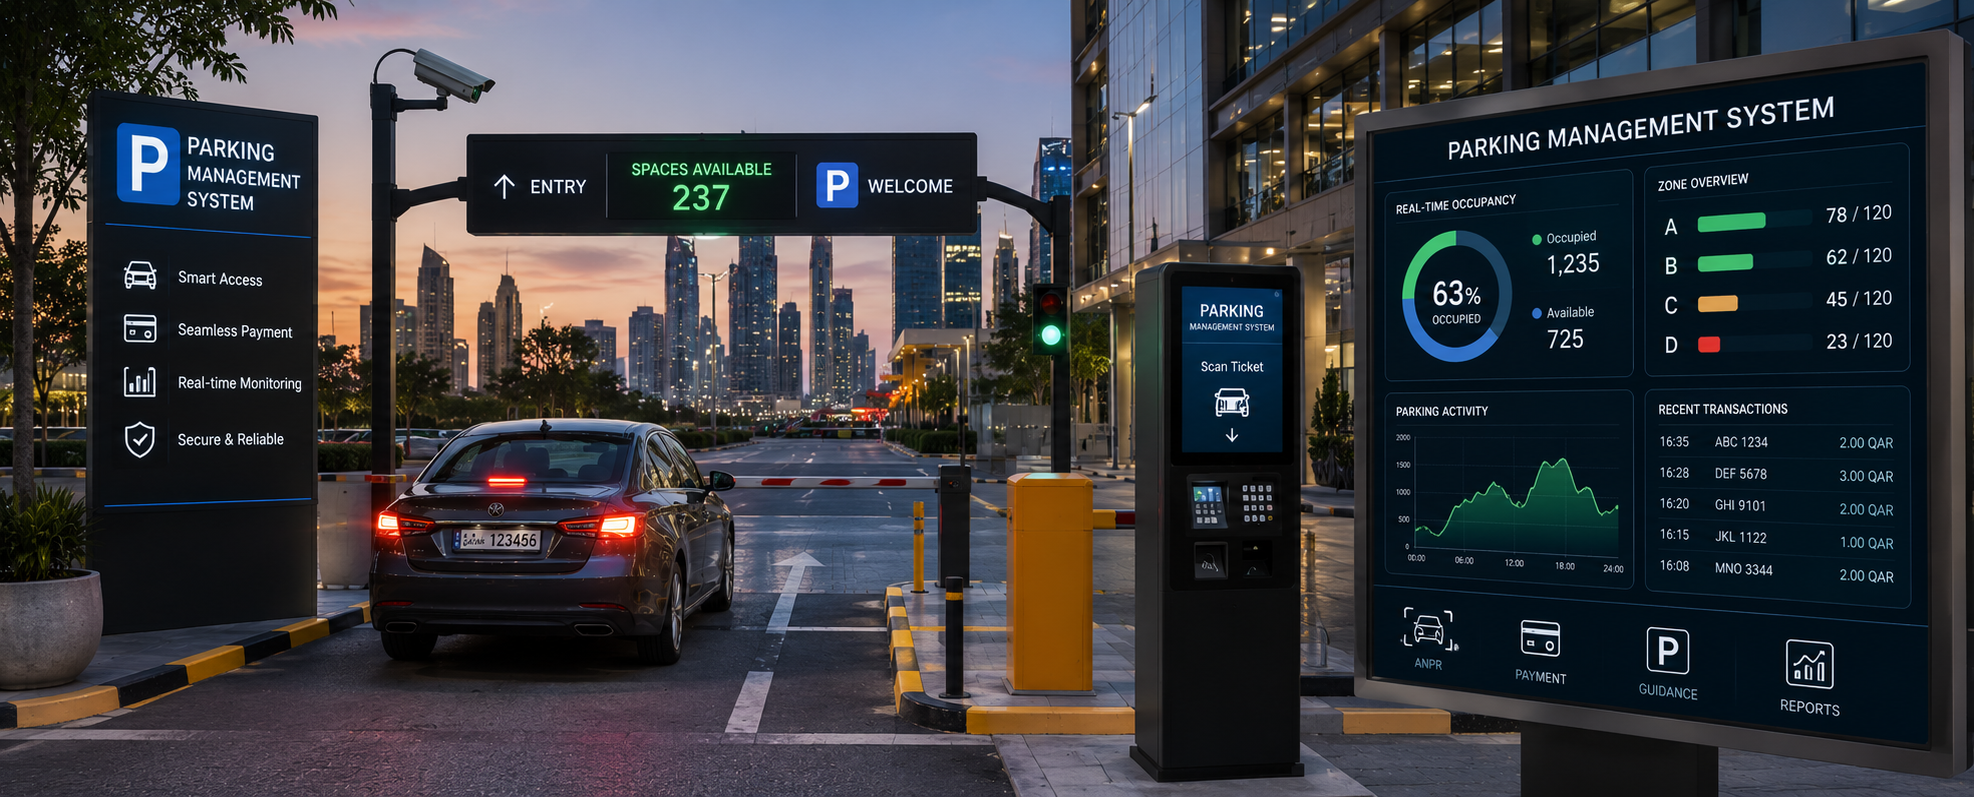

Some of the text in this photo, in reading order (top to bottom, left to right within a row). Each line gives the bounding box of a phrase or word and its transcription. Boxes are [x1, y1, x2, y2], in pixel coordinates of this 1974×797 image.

[1449, 96, 1833, 160] PARKING MANAGEMENT SYSTEM
[188, 137, 274, 162] PARKING
[132, 135, 168, 191] P
[632, 163, 771, 176] SPACES AVAILABLE
[187, 165, 301, 190] MANAGEMENT
[827, 170, 849, 201] P
[1658, 173, 1748, 191] ZONE OVERVIEW
[531, 180, 586, 193] ENTRY
[868, 179, 953, 193] WELCOME
[188, 191, 253, 210] SYSTEM
[673, 185, 729, 210] 237
[1397, 194, 1516, 214] REAL-TIME OCCUPANCY
[1665, 204, 1891, 235] A 78 / 120
[1547, 230, 1596, 244] Occupied
[1548, 253, 1599, 276] 1,235
[1666, 247, 1891, 274] B 62 / 120
[179, 271, 262, 286] Smart Access
[1434, 280, 1480, 306] 63%
[1665, 290, 1892, 314] C 45 / 120
[1201, 304, 1263, 317] PARKING
[1547, 306, 1594, 318] Available
[1189, 322, 1275, 332] MANAGEMENT SYSTEM
[1433, 314, 1481, 325] OCCUPIED
[179, 323, 292, 340] Seamless Payment
[1548, 329, 1583, 348] 725
[1666, 333, 1892, 353] D 23 / 120
[1201, 361, 1263, 372] Scan Ticket
[179, 376, 301, 392] Real-time Monitoring
[1396, 406, 1488, 417] PARKING ACTIVITY
[1659, 403, 1788, 414] RECENT TRANSACTIONS
[178, 433, 284, 446] Secure & Reliable
[1395, 433, 1411, 441] 2000
[1661, 436, 1893, 449] 16:35 ABC 1234 2.00 QAR
[1396, 460, 1411, 469] 1500
[1661, 467, 1893, 483] 16:28 DEF 5678 3.00 QAR
[1396, 488, 1411, 496] 1000
[1661, 498, 1893, 516] 16:20 GHI 9101 2.00 QAR
[1398, 515, 1410, 524] 500
[490, 533, 537, 547] 123456
[1661, 529, 1893, 549] 16:15 JKL 1122 1.00 QAR
[1661, 560, 1893, 583] 16:08 MNO 3344 2.00 QAR
[1659, 636, 1678, 665] P
[1415, 658, 1442, 670] ANPR
[1516, 669, 1566, 684] PAYMENT
[1639, 683, 1697, 700] GUIDANCE
[1781, 699, 1840, 716] REPORTS
